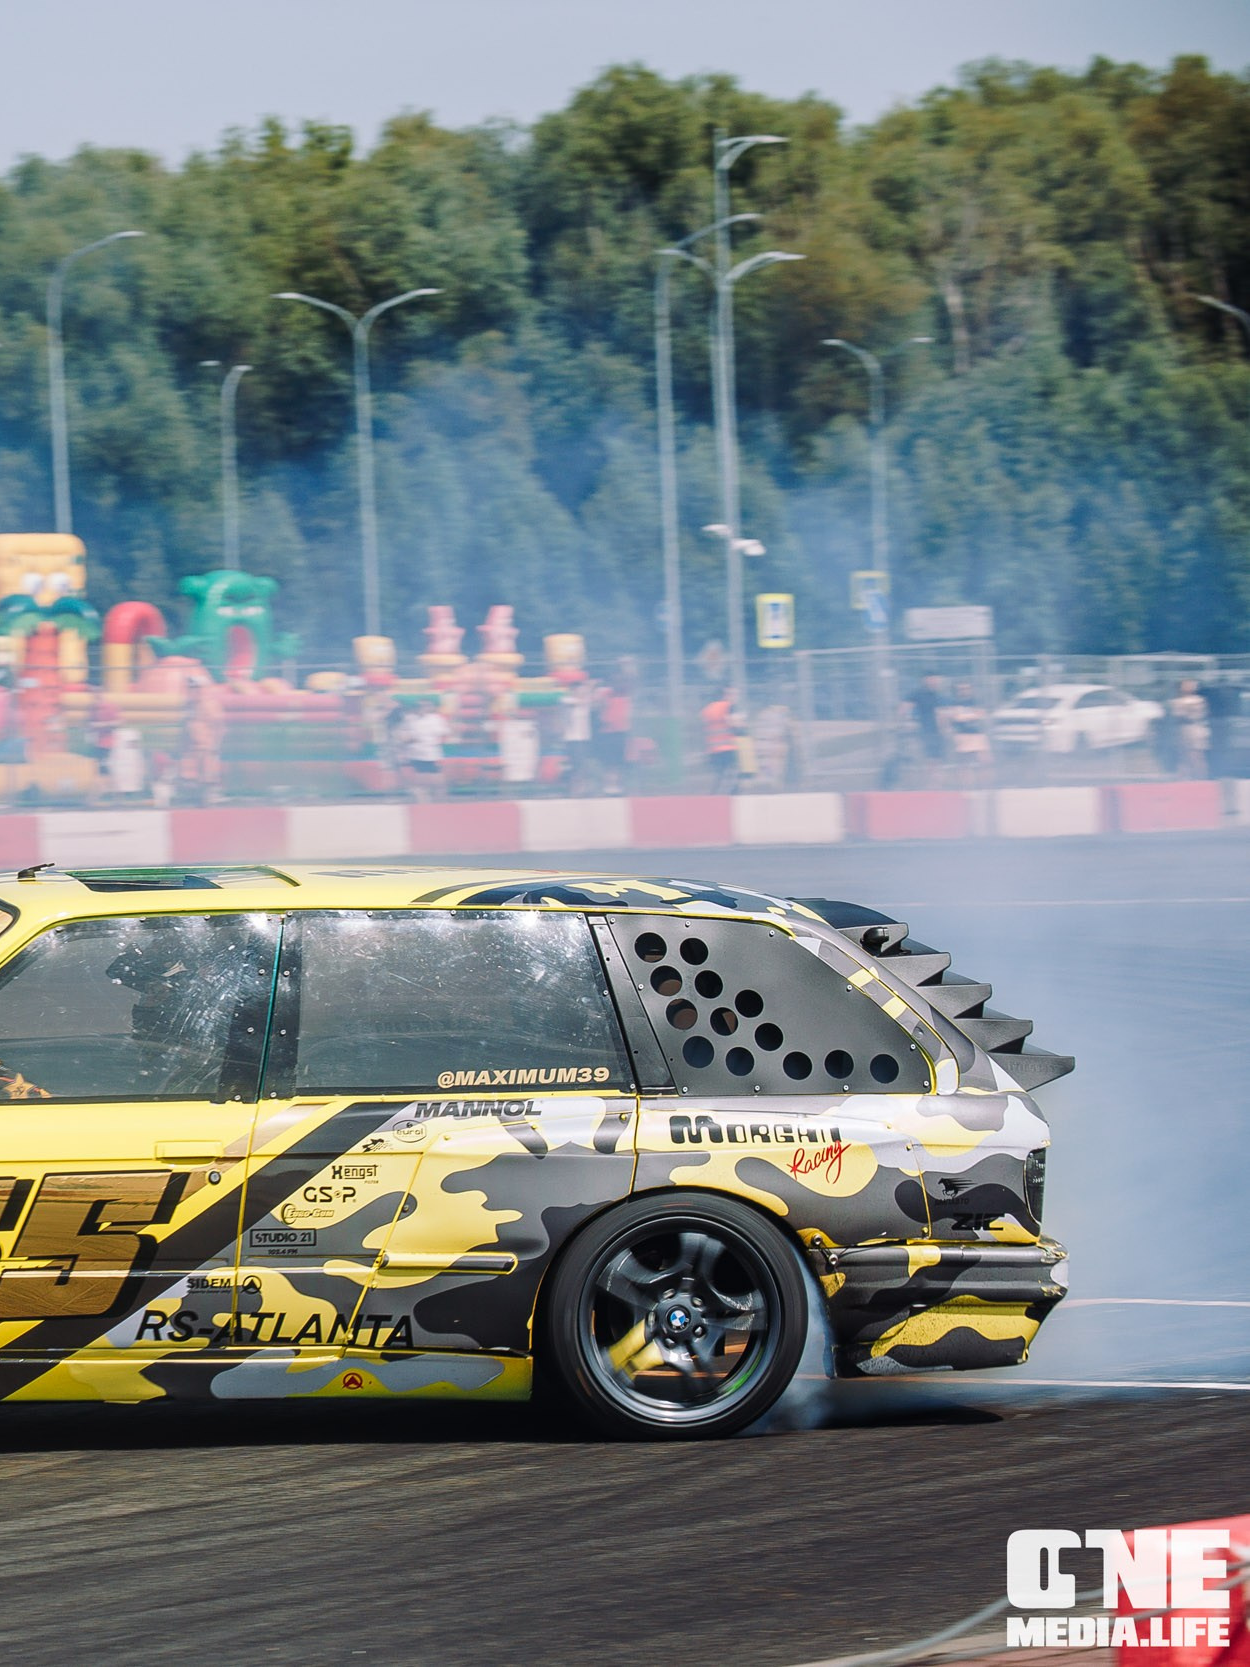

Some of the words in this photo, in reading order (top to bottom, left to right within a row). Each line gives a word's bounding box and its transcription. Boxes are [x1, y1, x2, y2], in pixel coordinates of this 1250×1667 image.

[437, 1067, 610, 1089] @MAXIMUM39
[414, 1101, 541, 1118] MANNOL
[786, 1140, 851, 1184] Racing
[331, 1164, 379, 1180] Hengst
[255, 1233, 297, 1243] STUDIO
[300, 1232, 312, 1243] 21
[187, 1277, 232, 1289] SIDEM
[135, 1310, 414, 1348] RS-ATLANTA
